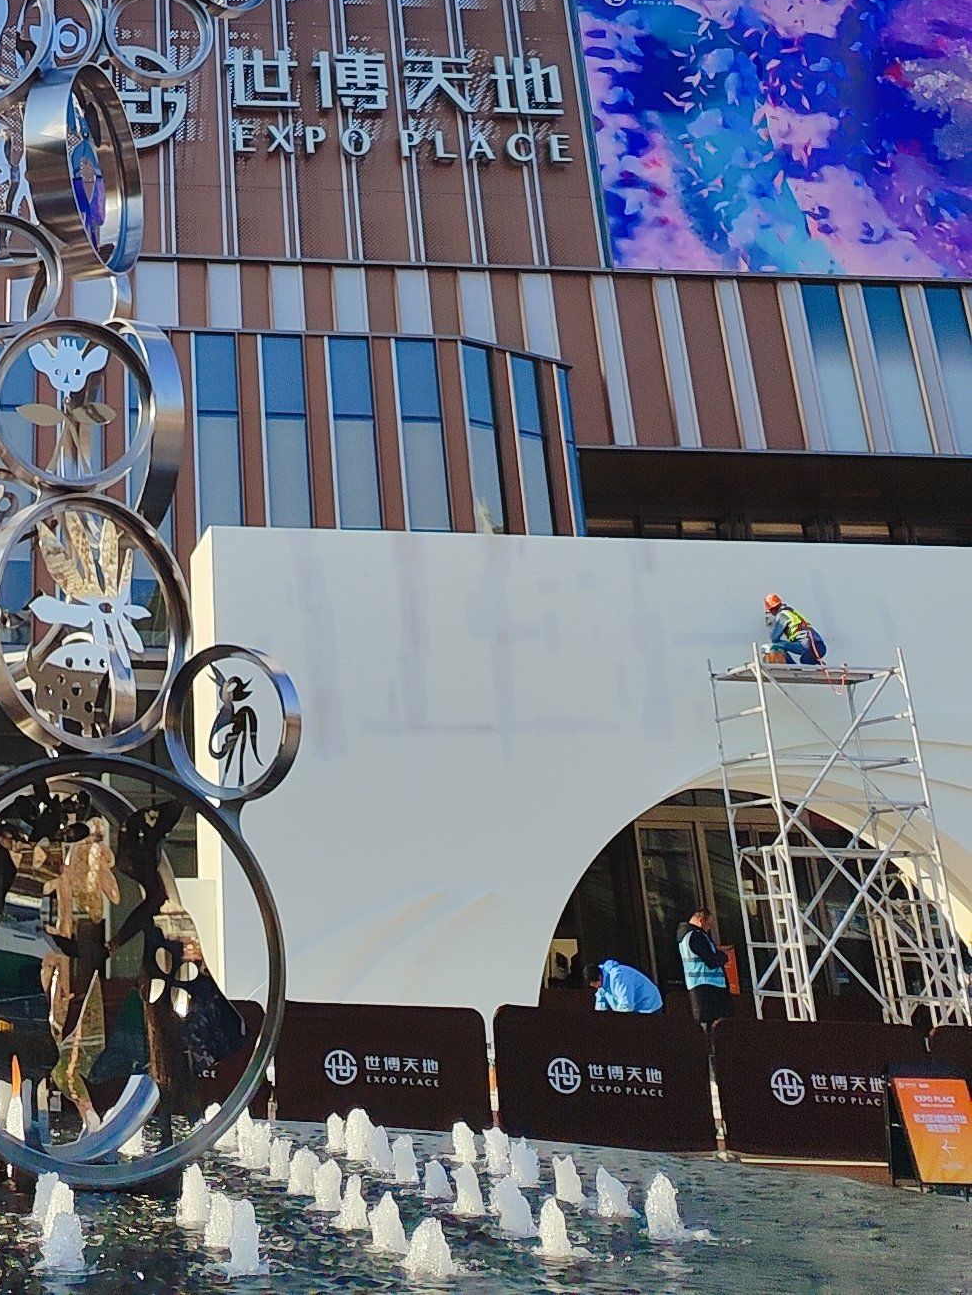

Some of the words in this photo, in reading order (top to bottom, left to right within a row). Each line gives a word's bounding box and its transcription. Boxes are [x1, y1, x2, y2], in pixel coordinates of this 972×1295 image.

[224, 46, 564, 117] 世博天地
[235, 123, 372, 158] EXPO
[399, 130, 574, 164] PLACE
[364, 1055, 439, 1074] 世博天地
[588, 1063, 663, 1084] 世博天地
[366, 1074, 397, 1084] EXPO
[401, 1077, 440, 1088] PLACE
[590, 1084, 622, 1094] EXPO
[625, 1086, 664, 1097] PLACE
[814, 1094, 846, 1104] EXPO
[850, 1096, 885, 1107] PLAC
